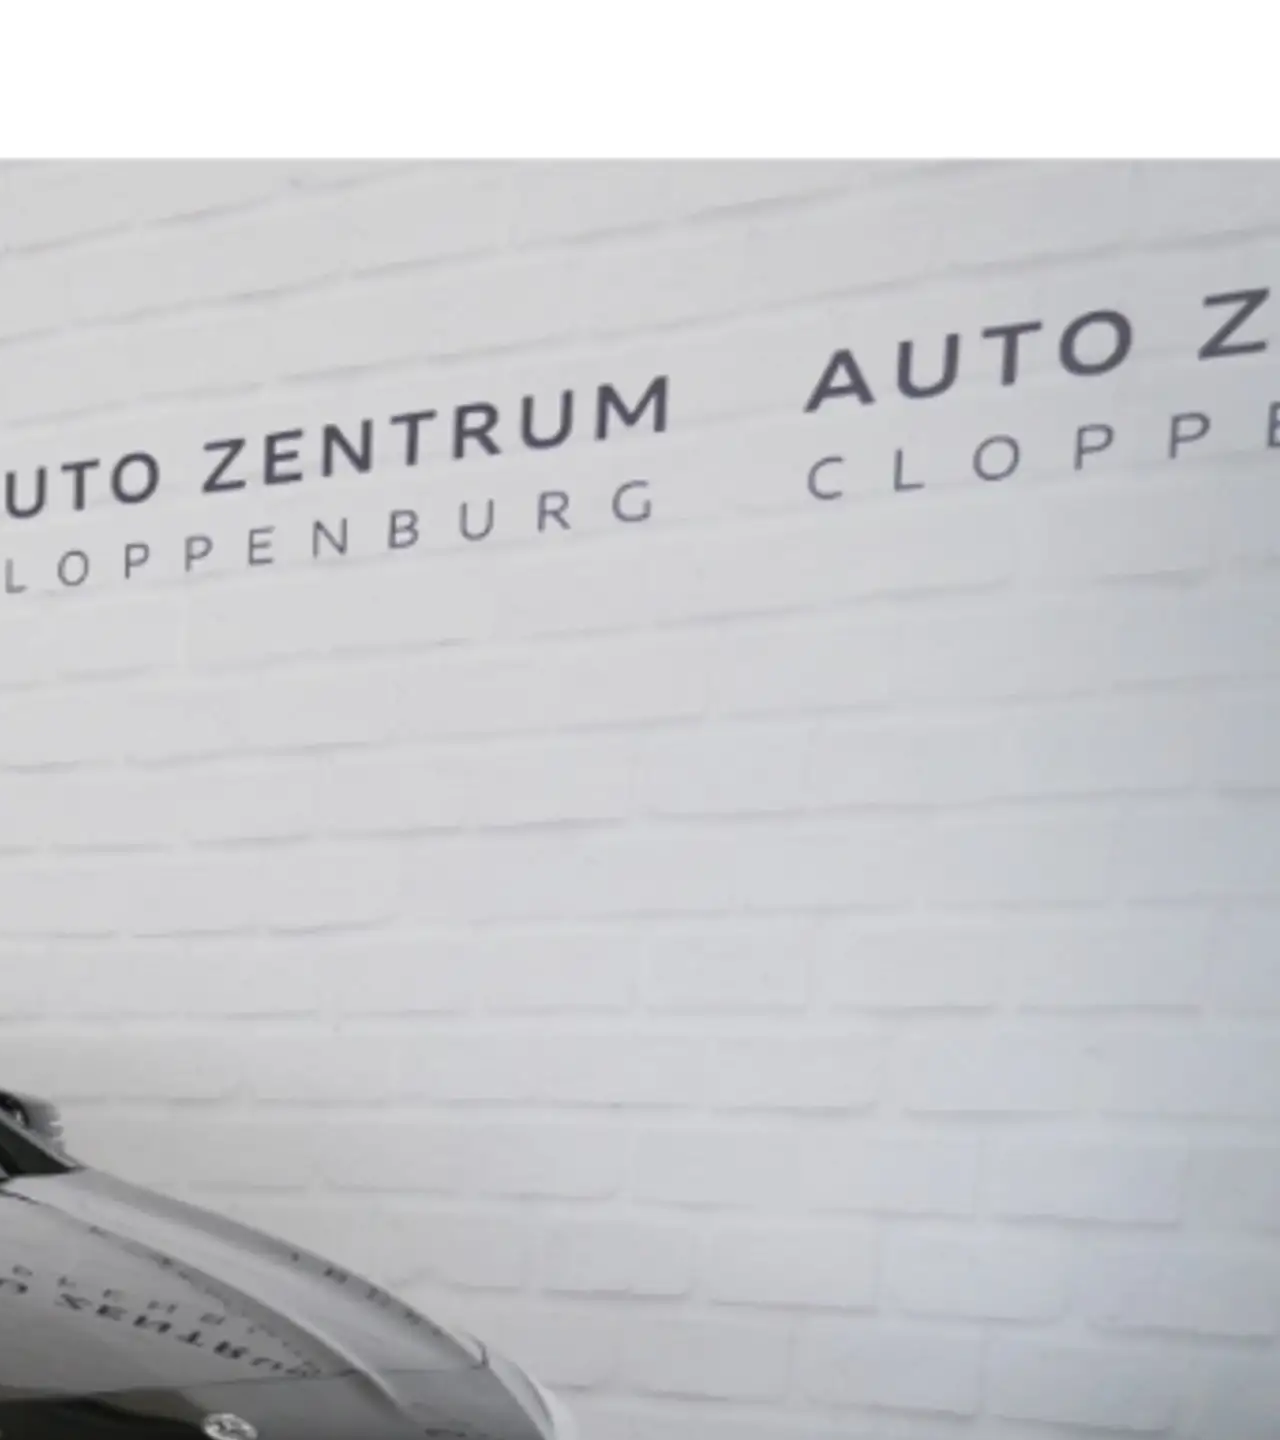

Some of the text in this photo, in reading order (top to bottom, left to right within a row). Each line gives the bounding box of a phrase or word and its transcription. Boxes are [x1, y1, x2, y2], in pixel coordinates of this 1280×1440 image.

[802, 286, 1271, 414] AUTO Z
[200, 374, 670, 495] ZENTRUM
